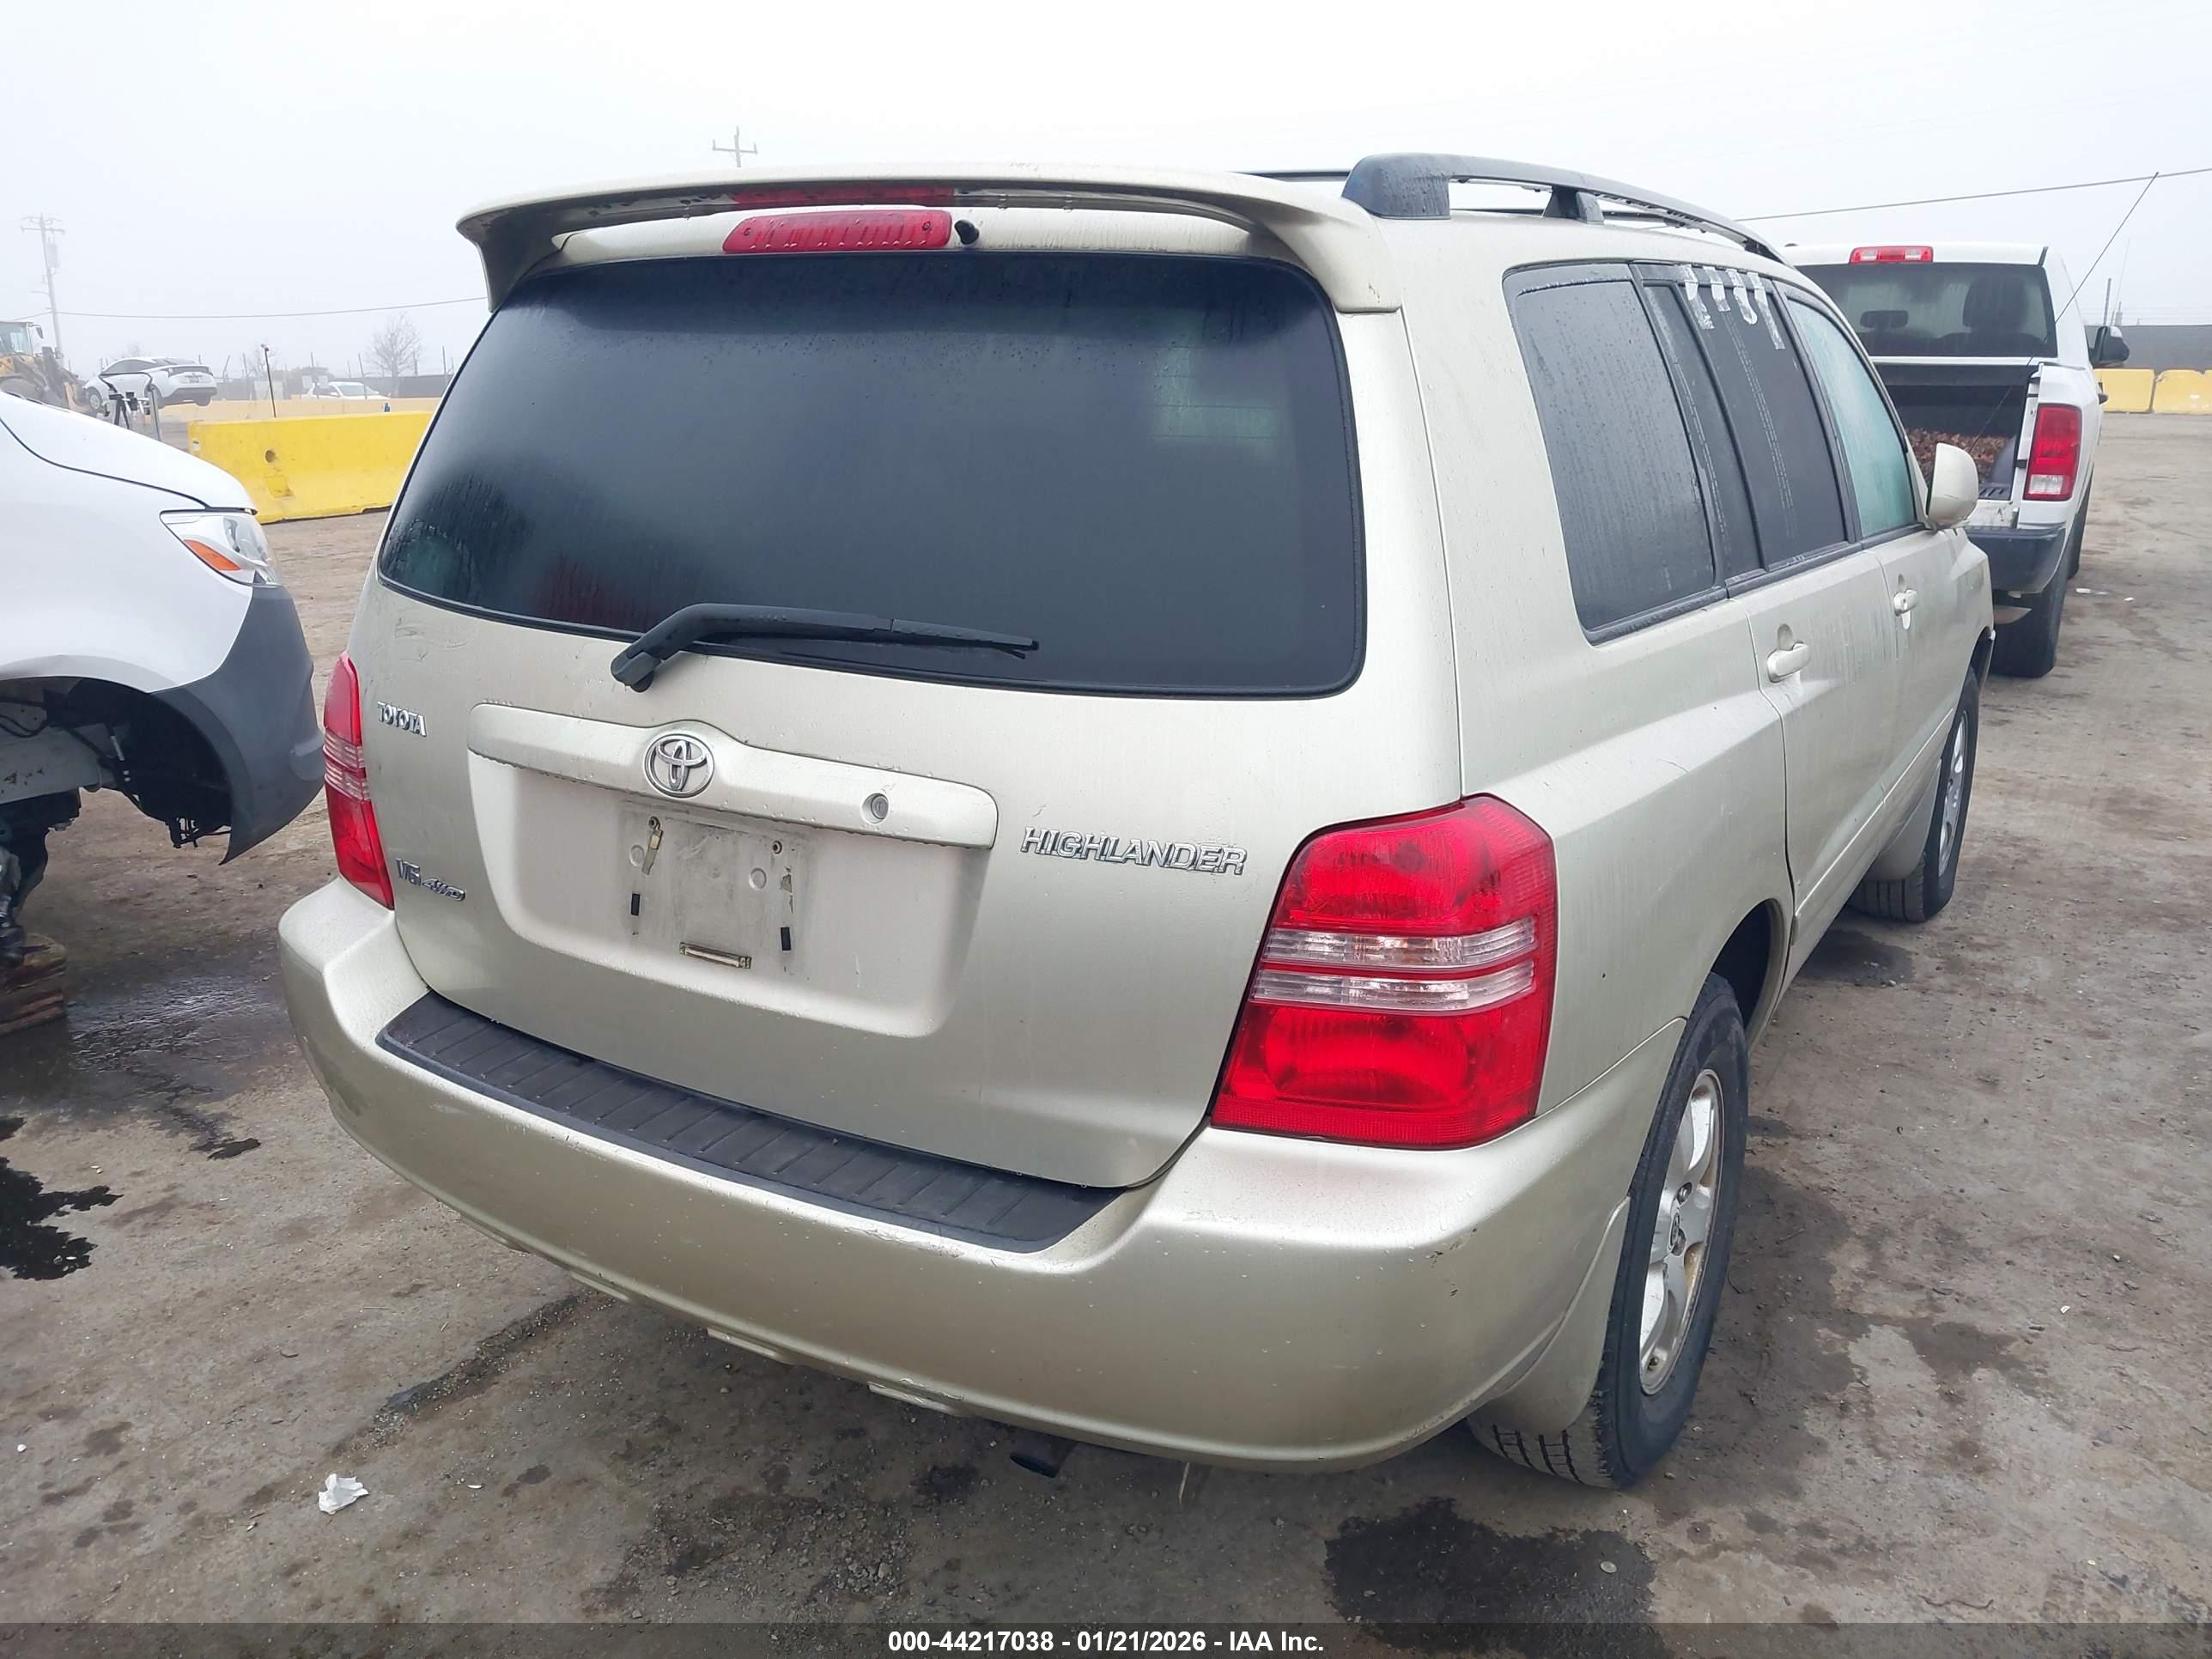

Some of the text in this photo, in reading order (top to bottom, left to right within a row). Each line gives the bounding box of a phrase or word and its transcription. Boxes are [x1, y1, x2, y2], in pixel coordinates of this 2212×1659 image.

[377, 701, 428, 738] TOYOTA
[1021, 827, 1248, 875] HIGHLANDER
[396, 858, 467, 902] V6 4WD
